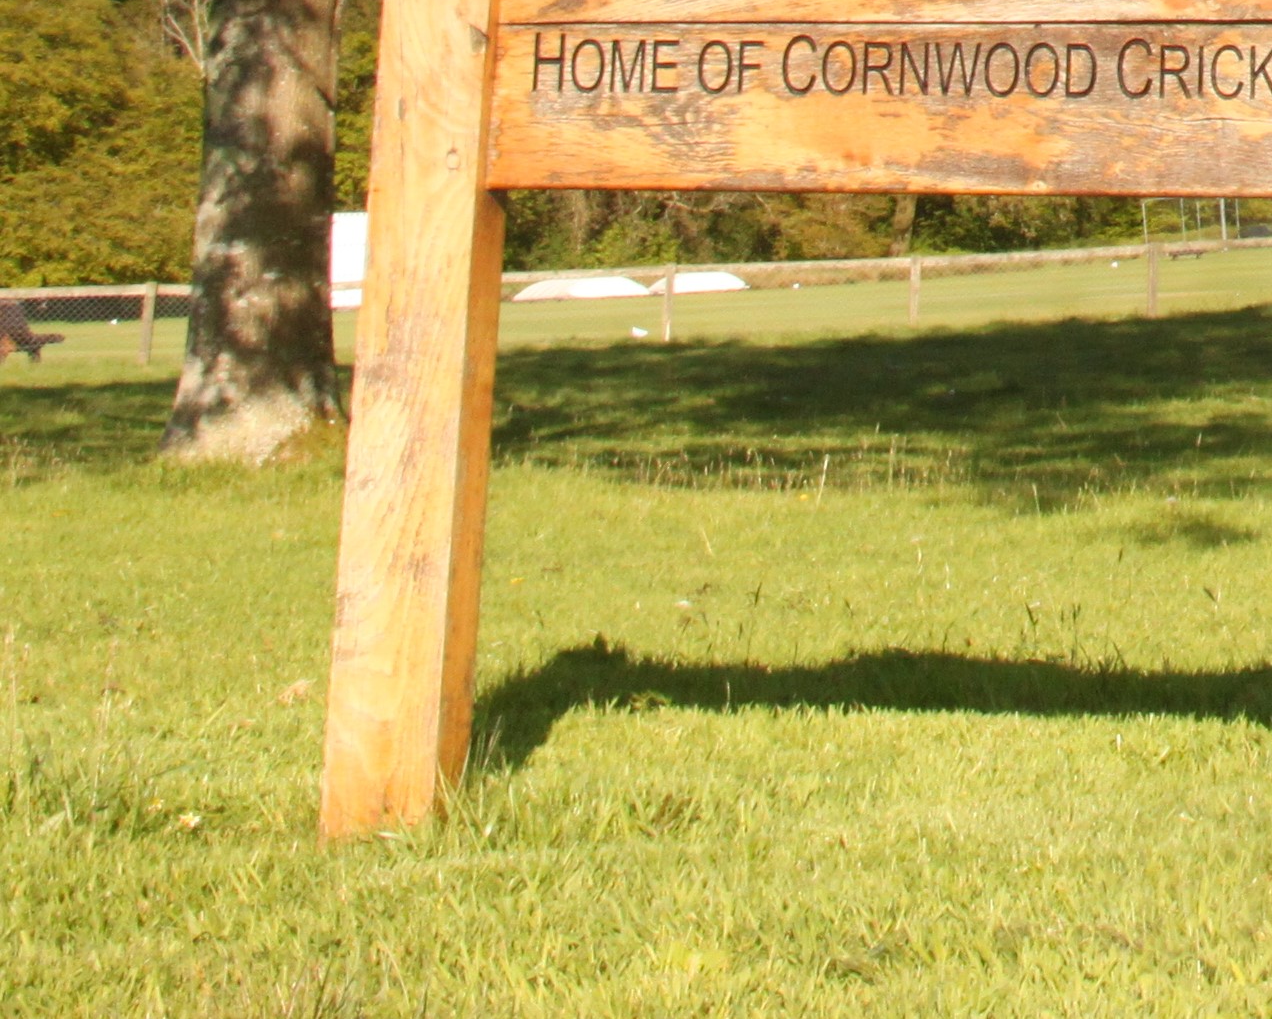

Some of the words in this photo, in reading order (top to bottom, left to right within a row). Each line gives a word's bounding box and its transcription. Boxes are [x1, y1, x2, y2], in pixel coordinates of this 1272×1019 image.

[531, 31, 681, 94] HOME
[699, 38, 766, 95] OF
[782, 34, 1098, 99] CORNWOOD
